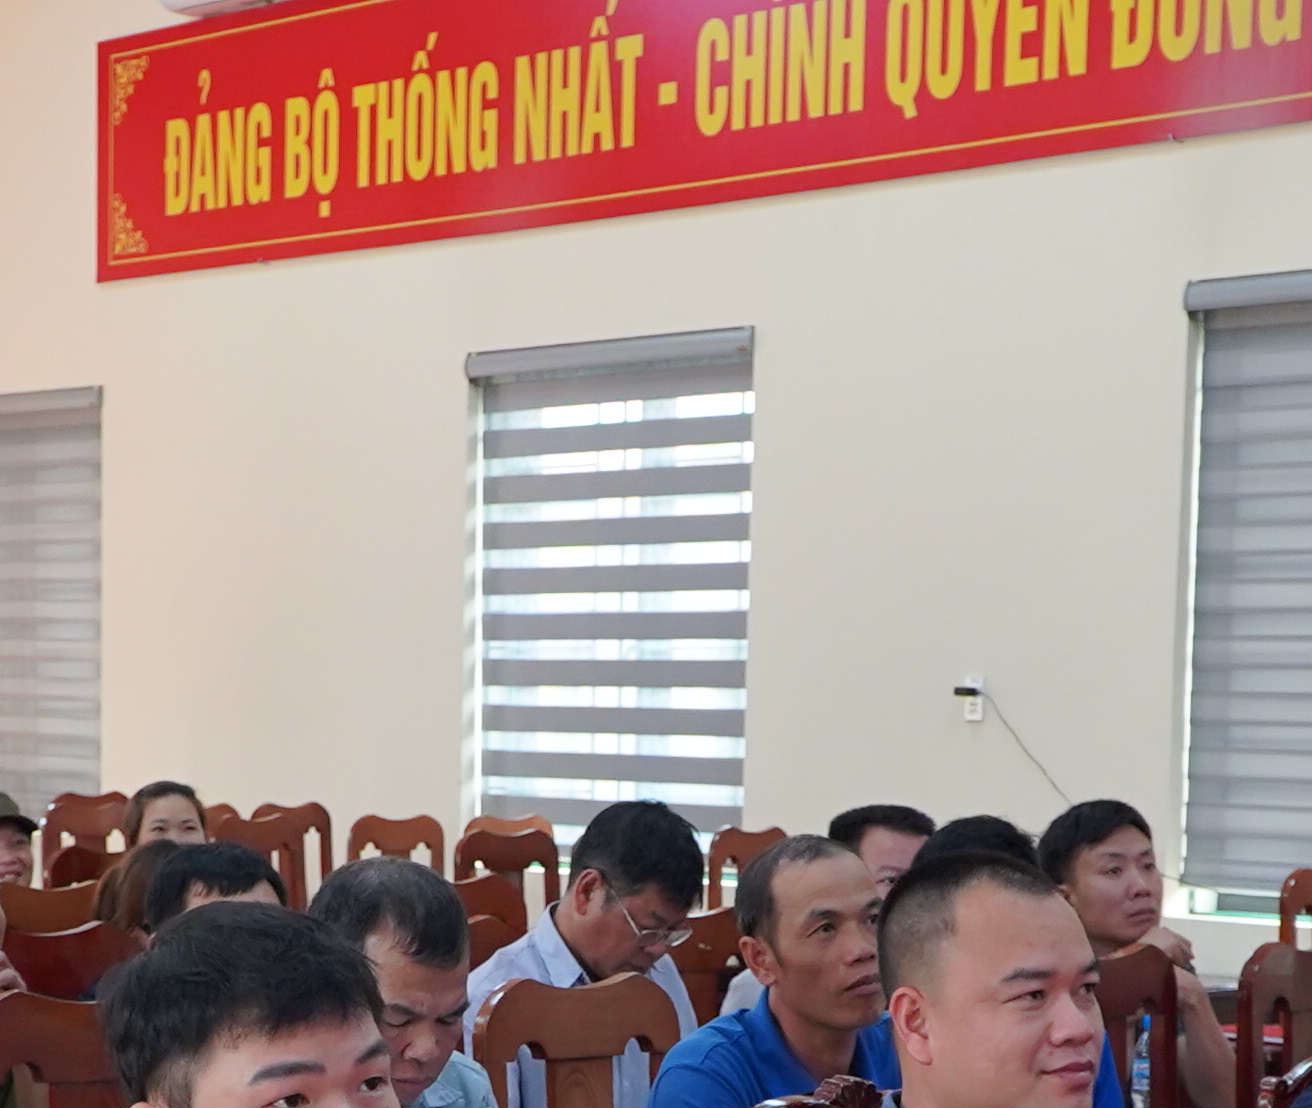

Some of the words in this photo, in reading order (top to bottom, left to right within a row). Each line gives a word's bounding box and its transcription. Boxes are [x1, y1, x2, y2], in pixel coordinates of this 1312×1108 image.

[163, 70, 271, 215] ĐẢNG
[284, 68, 339, 218] BỘ
[352, 32, 498, 188] THỐNG
[514, 0, 643, 163] NHẤT
[696, 0, 866, 136] CHÍNH
